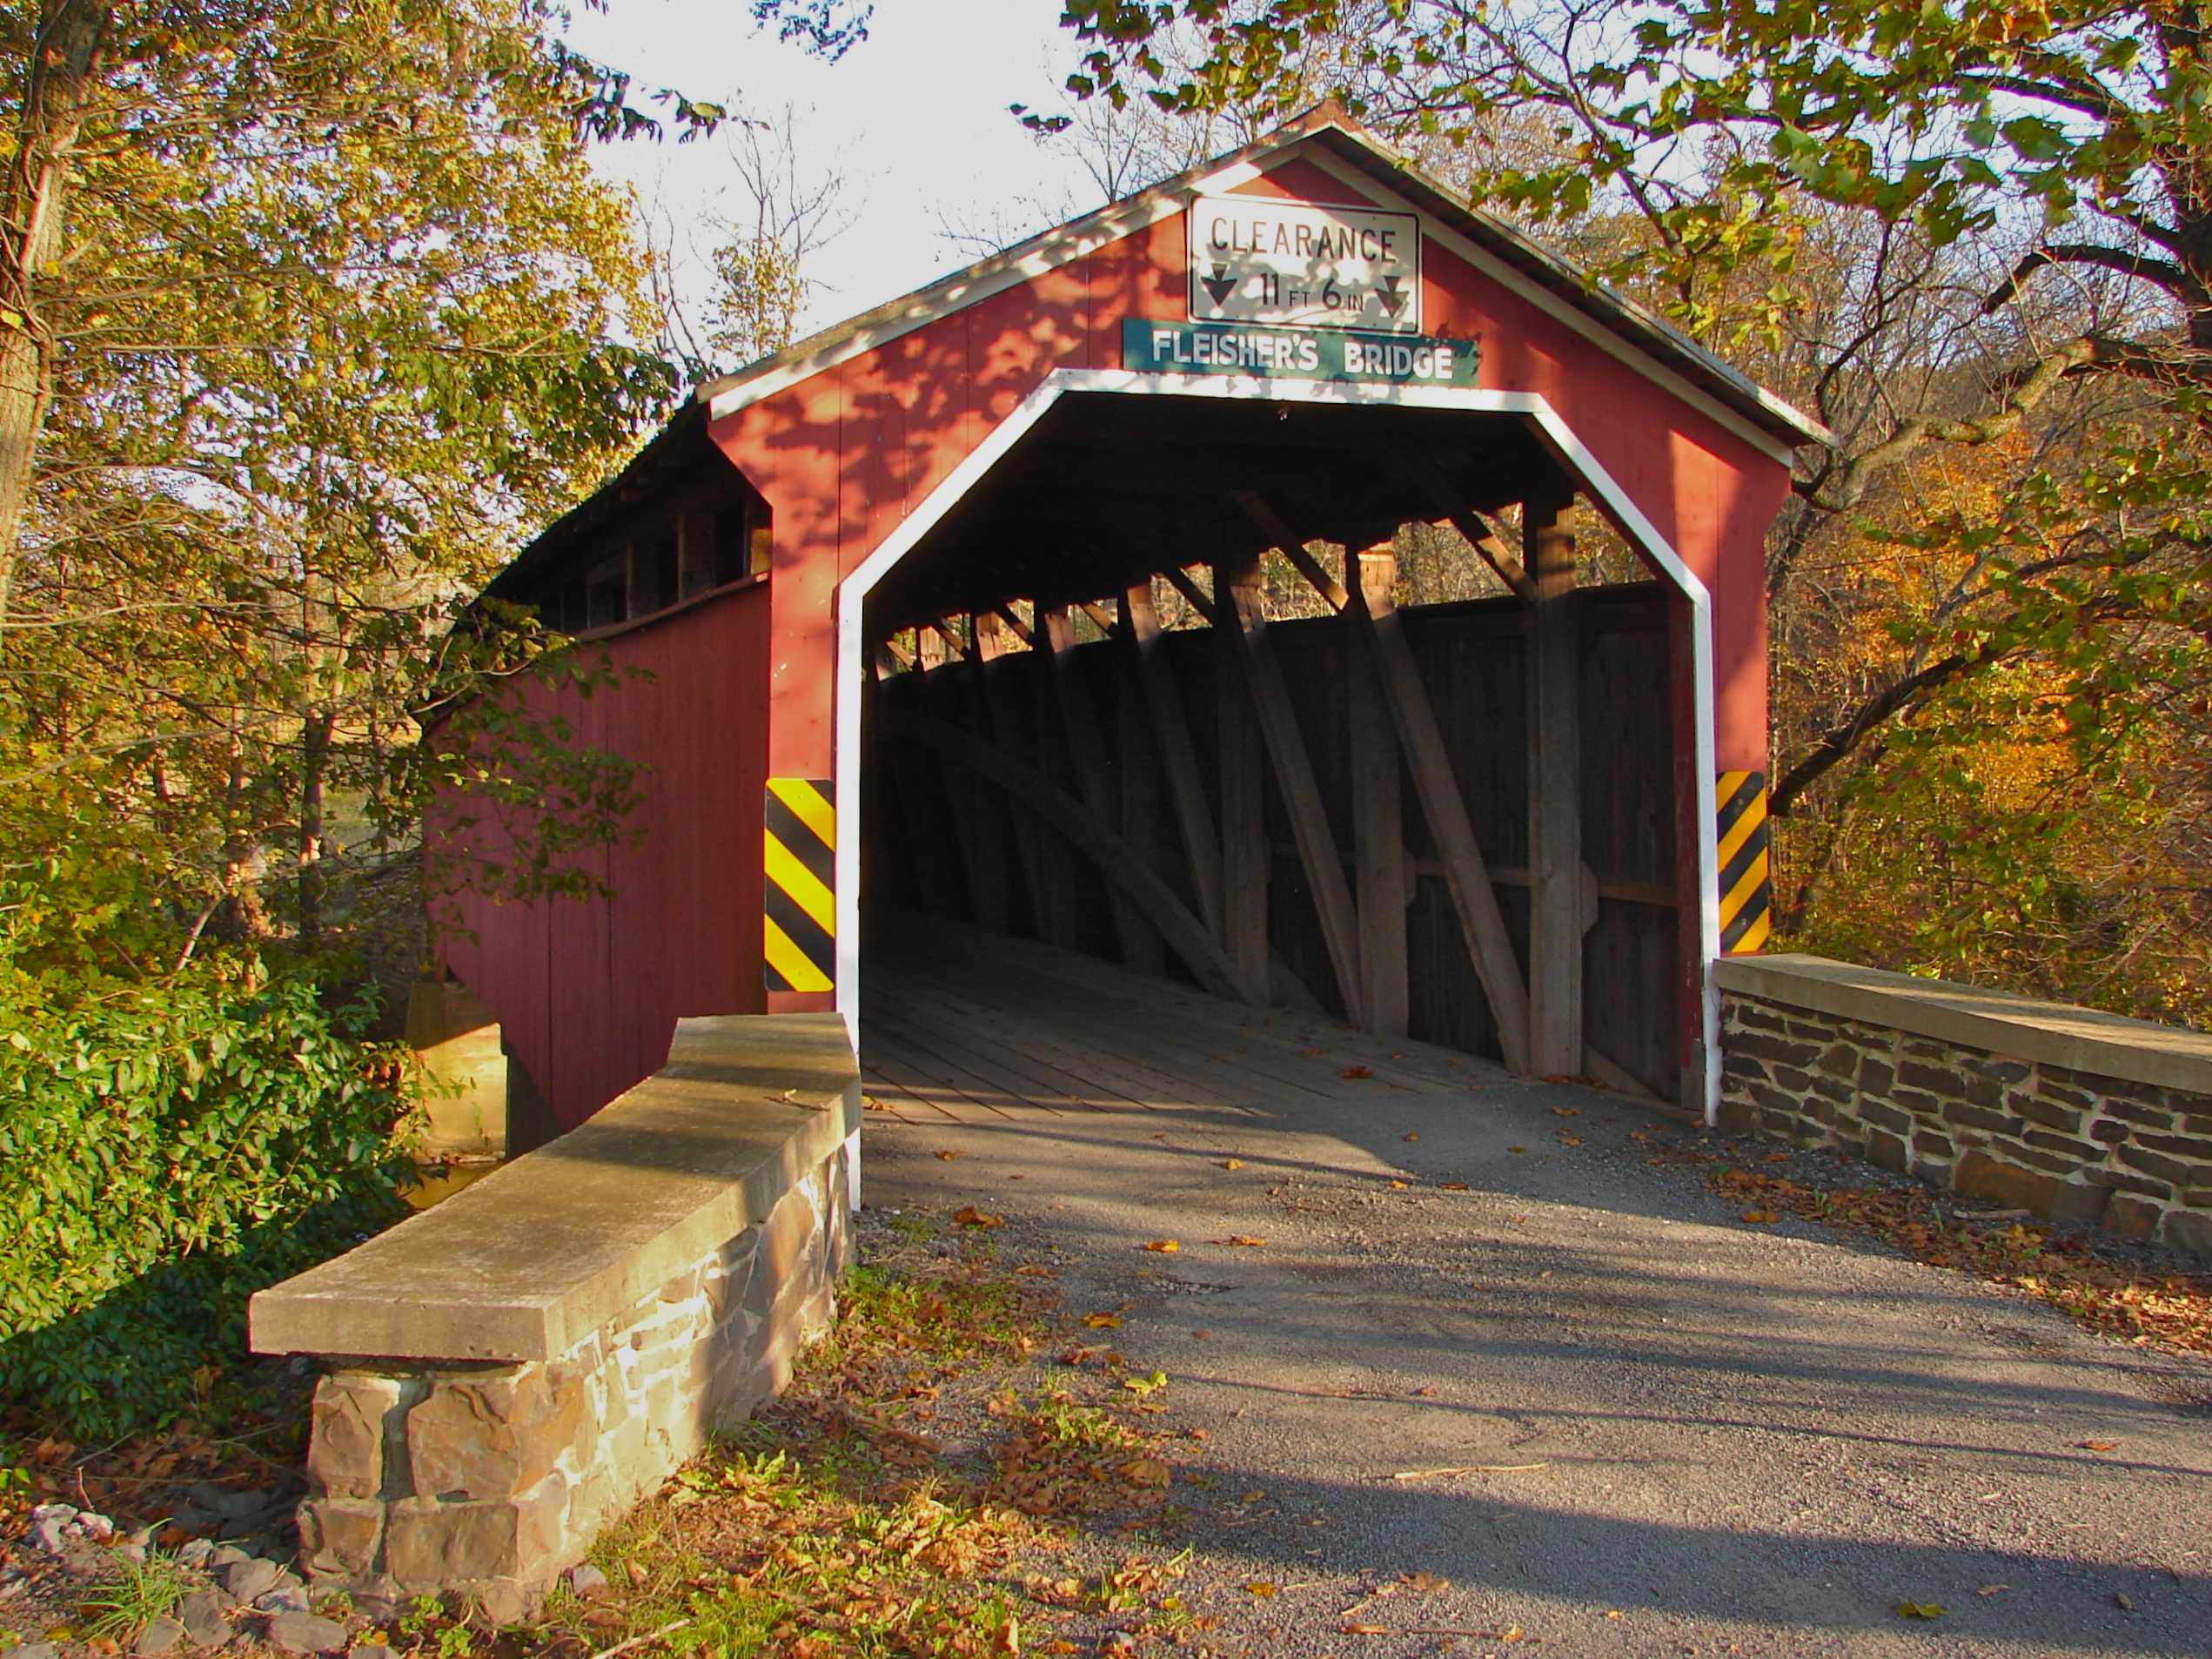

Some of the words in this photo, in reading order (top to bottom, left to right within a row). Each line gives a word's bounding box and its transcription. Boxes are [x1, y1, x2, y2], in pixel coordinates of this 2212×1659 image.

[1211, 217, 1397, 264] CLEARANCE
[1260, 272, 1279, 306] 11
[1289, 290, 1310, 307] FT
[1322, 278, 1342, 310] 6
[1348, 294, 1364, 312] IN
[1152, 329, 1319, 371] FLEISHER'S
[1343, 341, 1453, 379] BRIDGE
